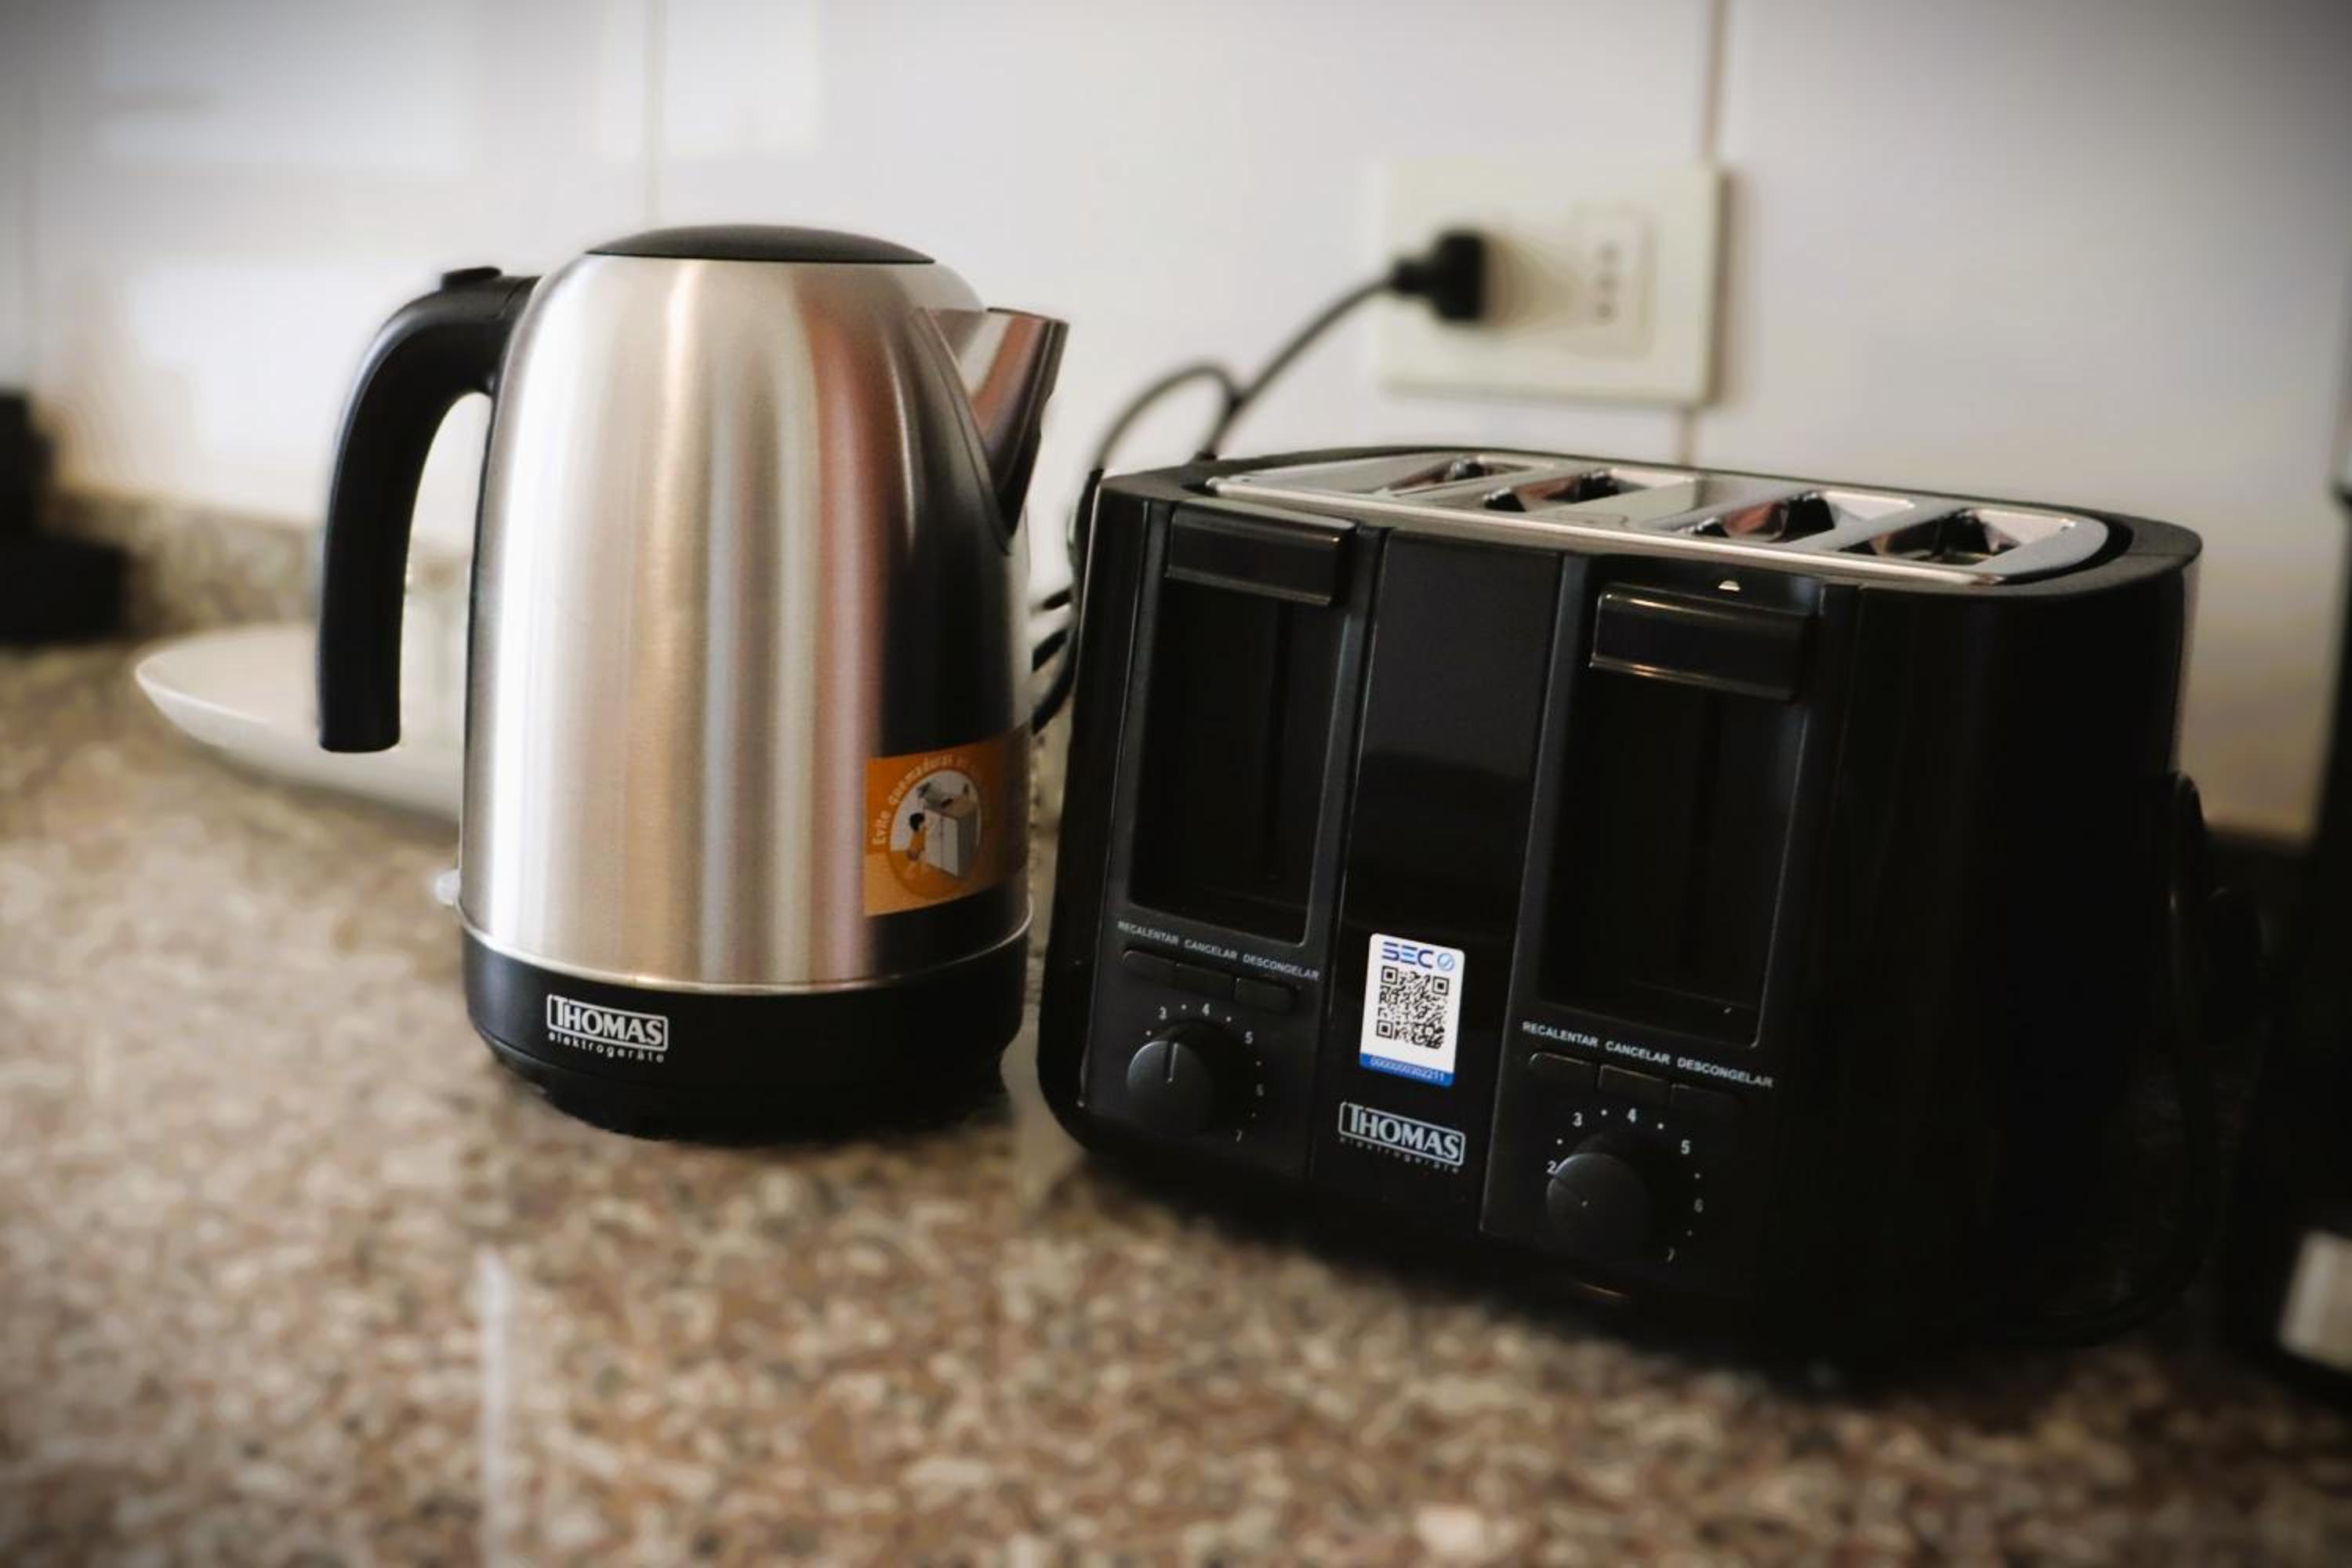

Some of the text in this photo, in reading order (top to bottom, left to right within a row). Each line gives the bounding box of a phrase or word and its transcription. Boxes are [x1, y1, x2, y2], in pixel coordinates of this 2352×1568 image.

[1116, 920, 1320, 981] RECALENTAR CANCELAR DESCONGELAR
[1381, 942, 1435, 969] SEC
[552, 996, 664, 1046] THOMAS
[1158, 1006, 1168, 1020] 3
[1244, 1030, 1254, 1044] 5
[1522, 1020, 1774, 1089] RECALENTAR CANCELAR DESCONGELAR
[1572, 1111, 1583, 1127] 3
[1626, 1107, 1638, 1123] 4
[1346, 1102, 1460, 1160] THOMAS
[1680, 1138, 1691, 1155] 5
[1546, 1160, 1557, 1175] 2
[1693, 1198, 1704, 1214] 6
